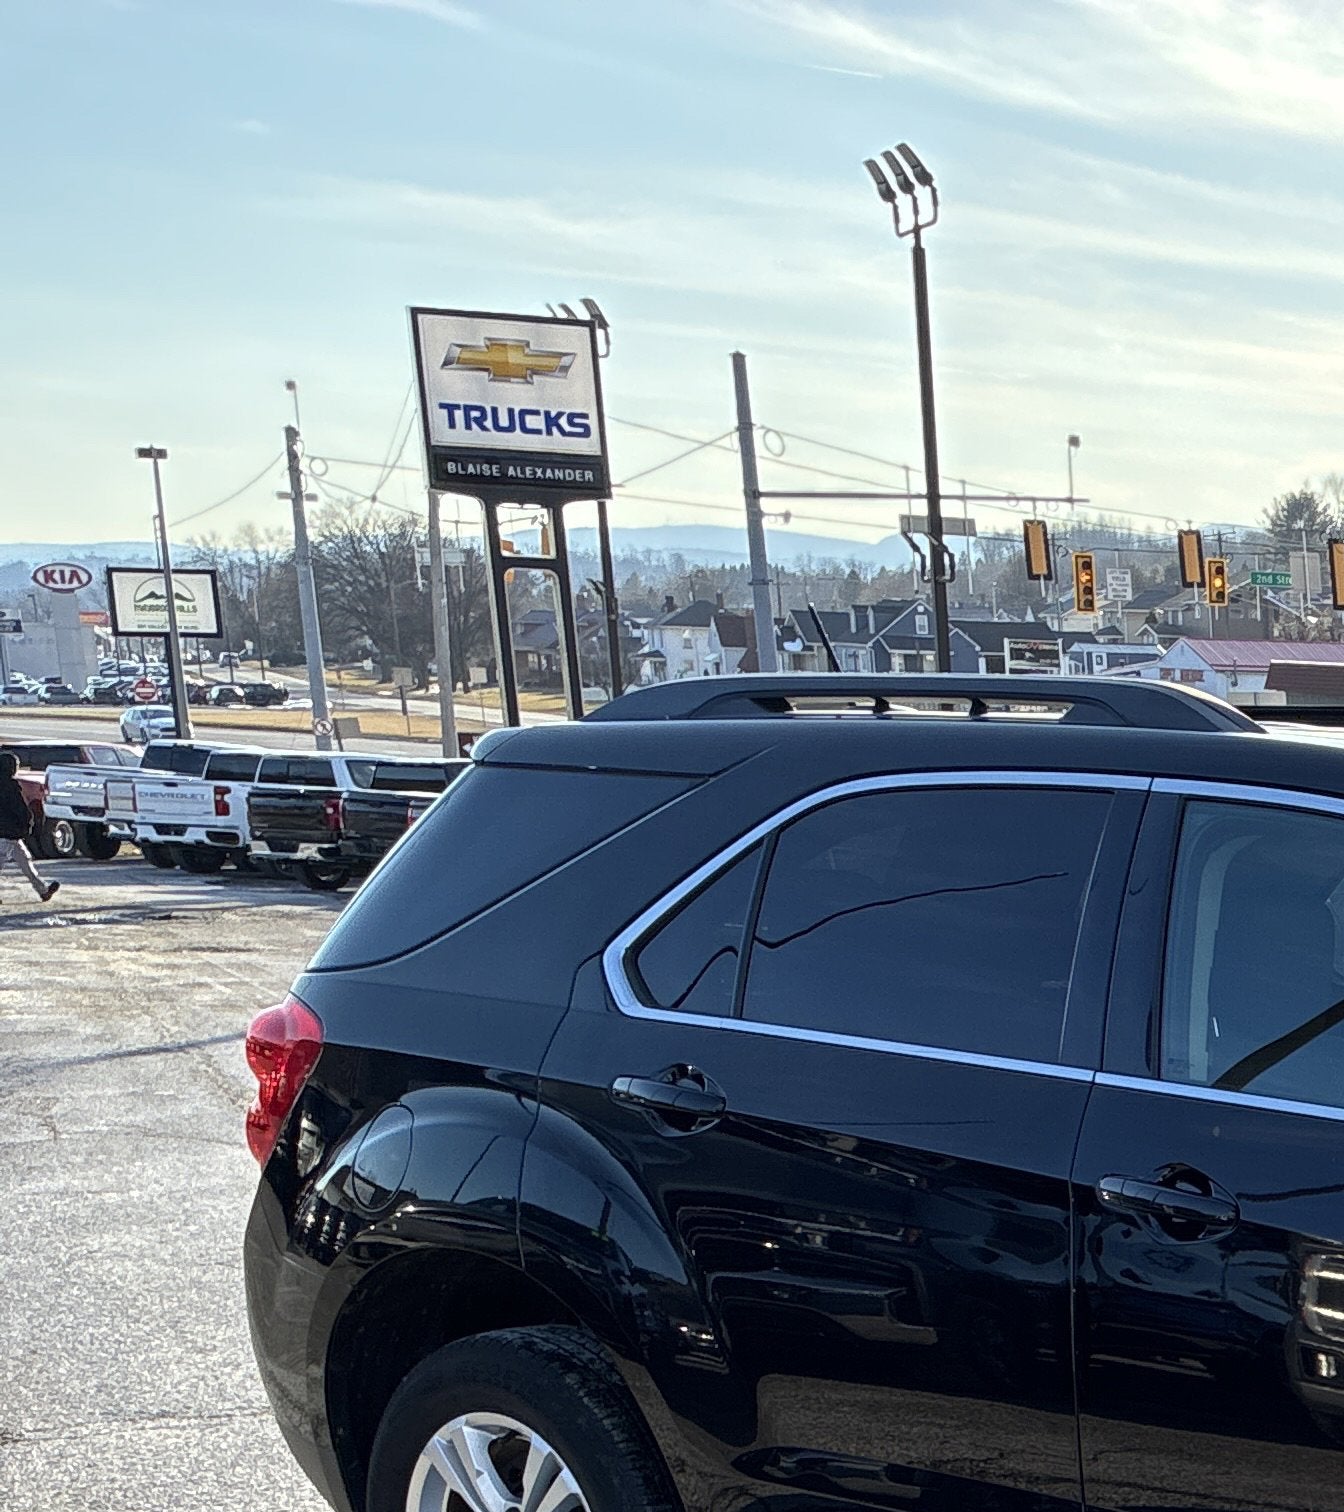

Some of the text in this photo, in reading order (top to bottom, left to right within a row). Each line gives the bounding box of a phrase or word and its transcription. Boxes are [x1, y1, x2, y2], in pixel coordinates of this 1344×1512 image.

[438, 402, 592, 439] TRUCKS
[447, 461, 594, 483] BLAISE ALEXANDER
[43, 569, 83, 585] KIA
[1256, 574, 1273, 584] 2nd
[138, 791, 206, 801] CHEVROLET
